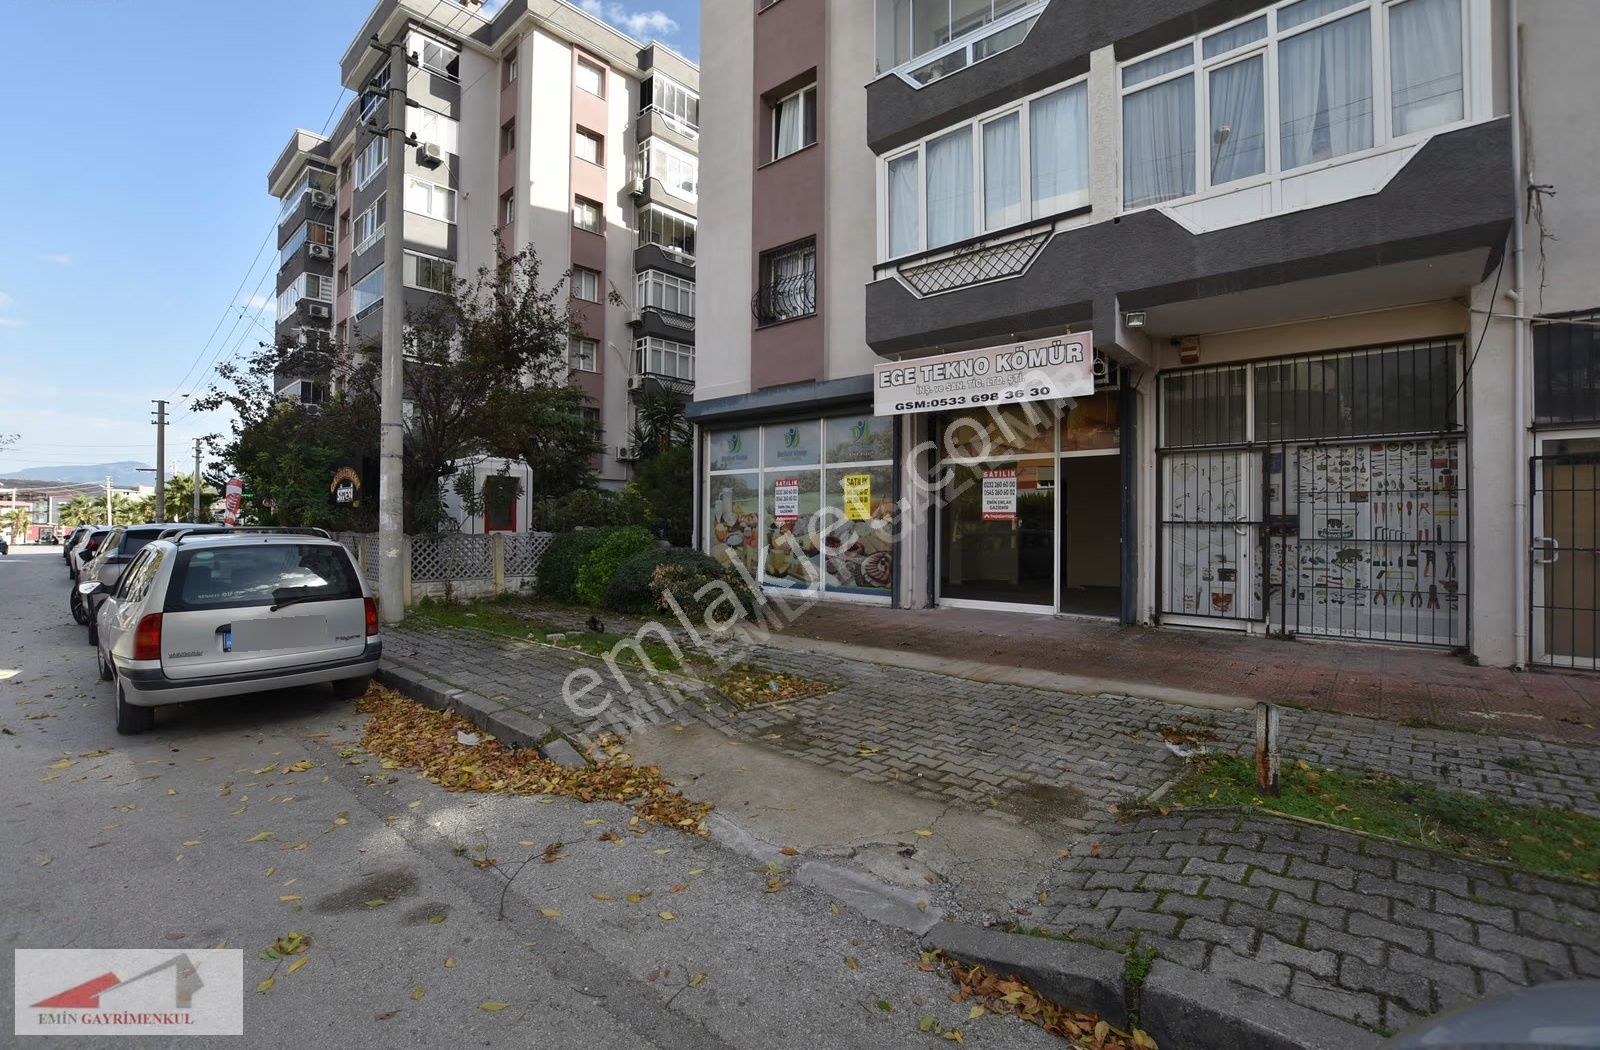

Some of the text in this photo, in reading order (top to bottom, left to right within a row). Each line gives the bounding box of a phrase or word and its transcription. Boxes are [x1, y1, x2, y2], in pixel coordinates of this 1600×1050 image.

[880, 340, 1083, 389] EGE TEKNO KÖMÜR
[934, 386, 944, 394] ve
[895, 386, 1050, 411] GSM:0533 698 36 30
[983, 470, 1016, 478] SATILIK
